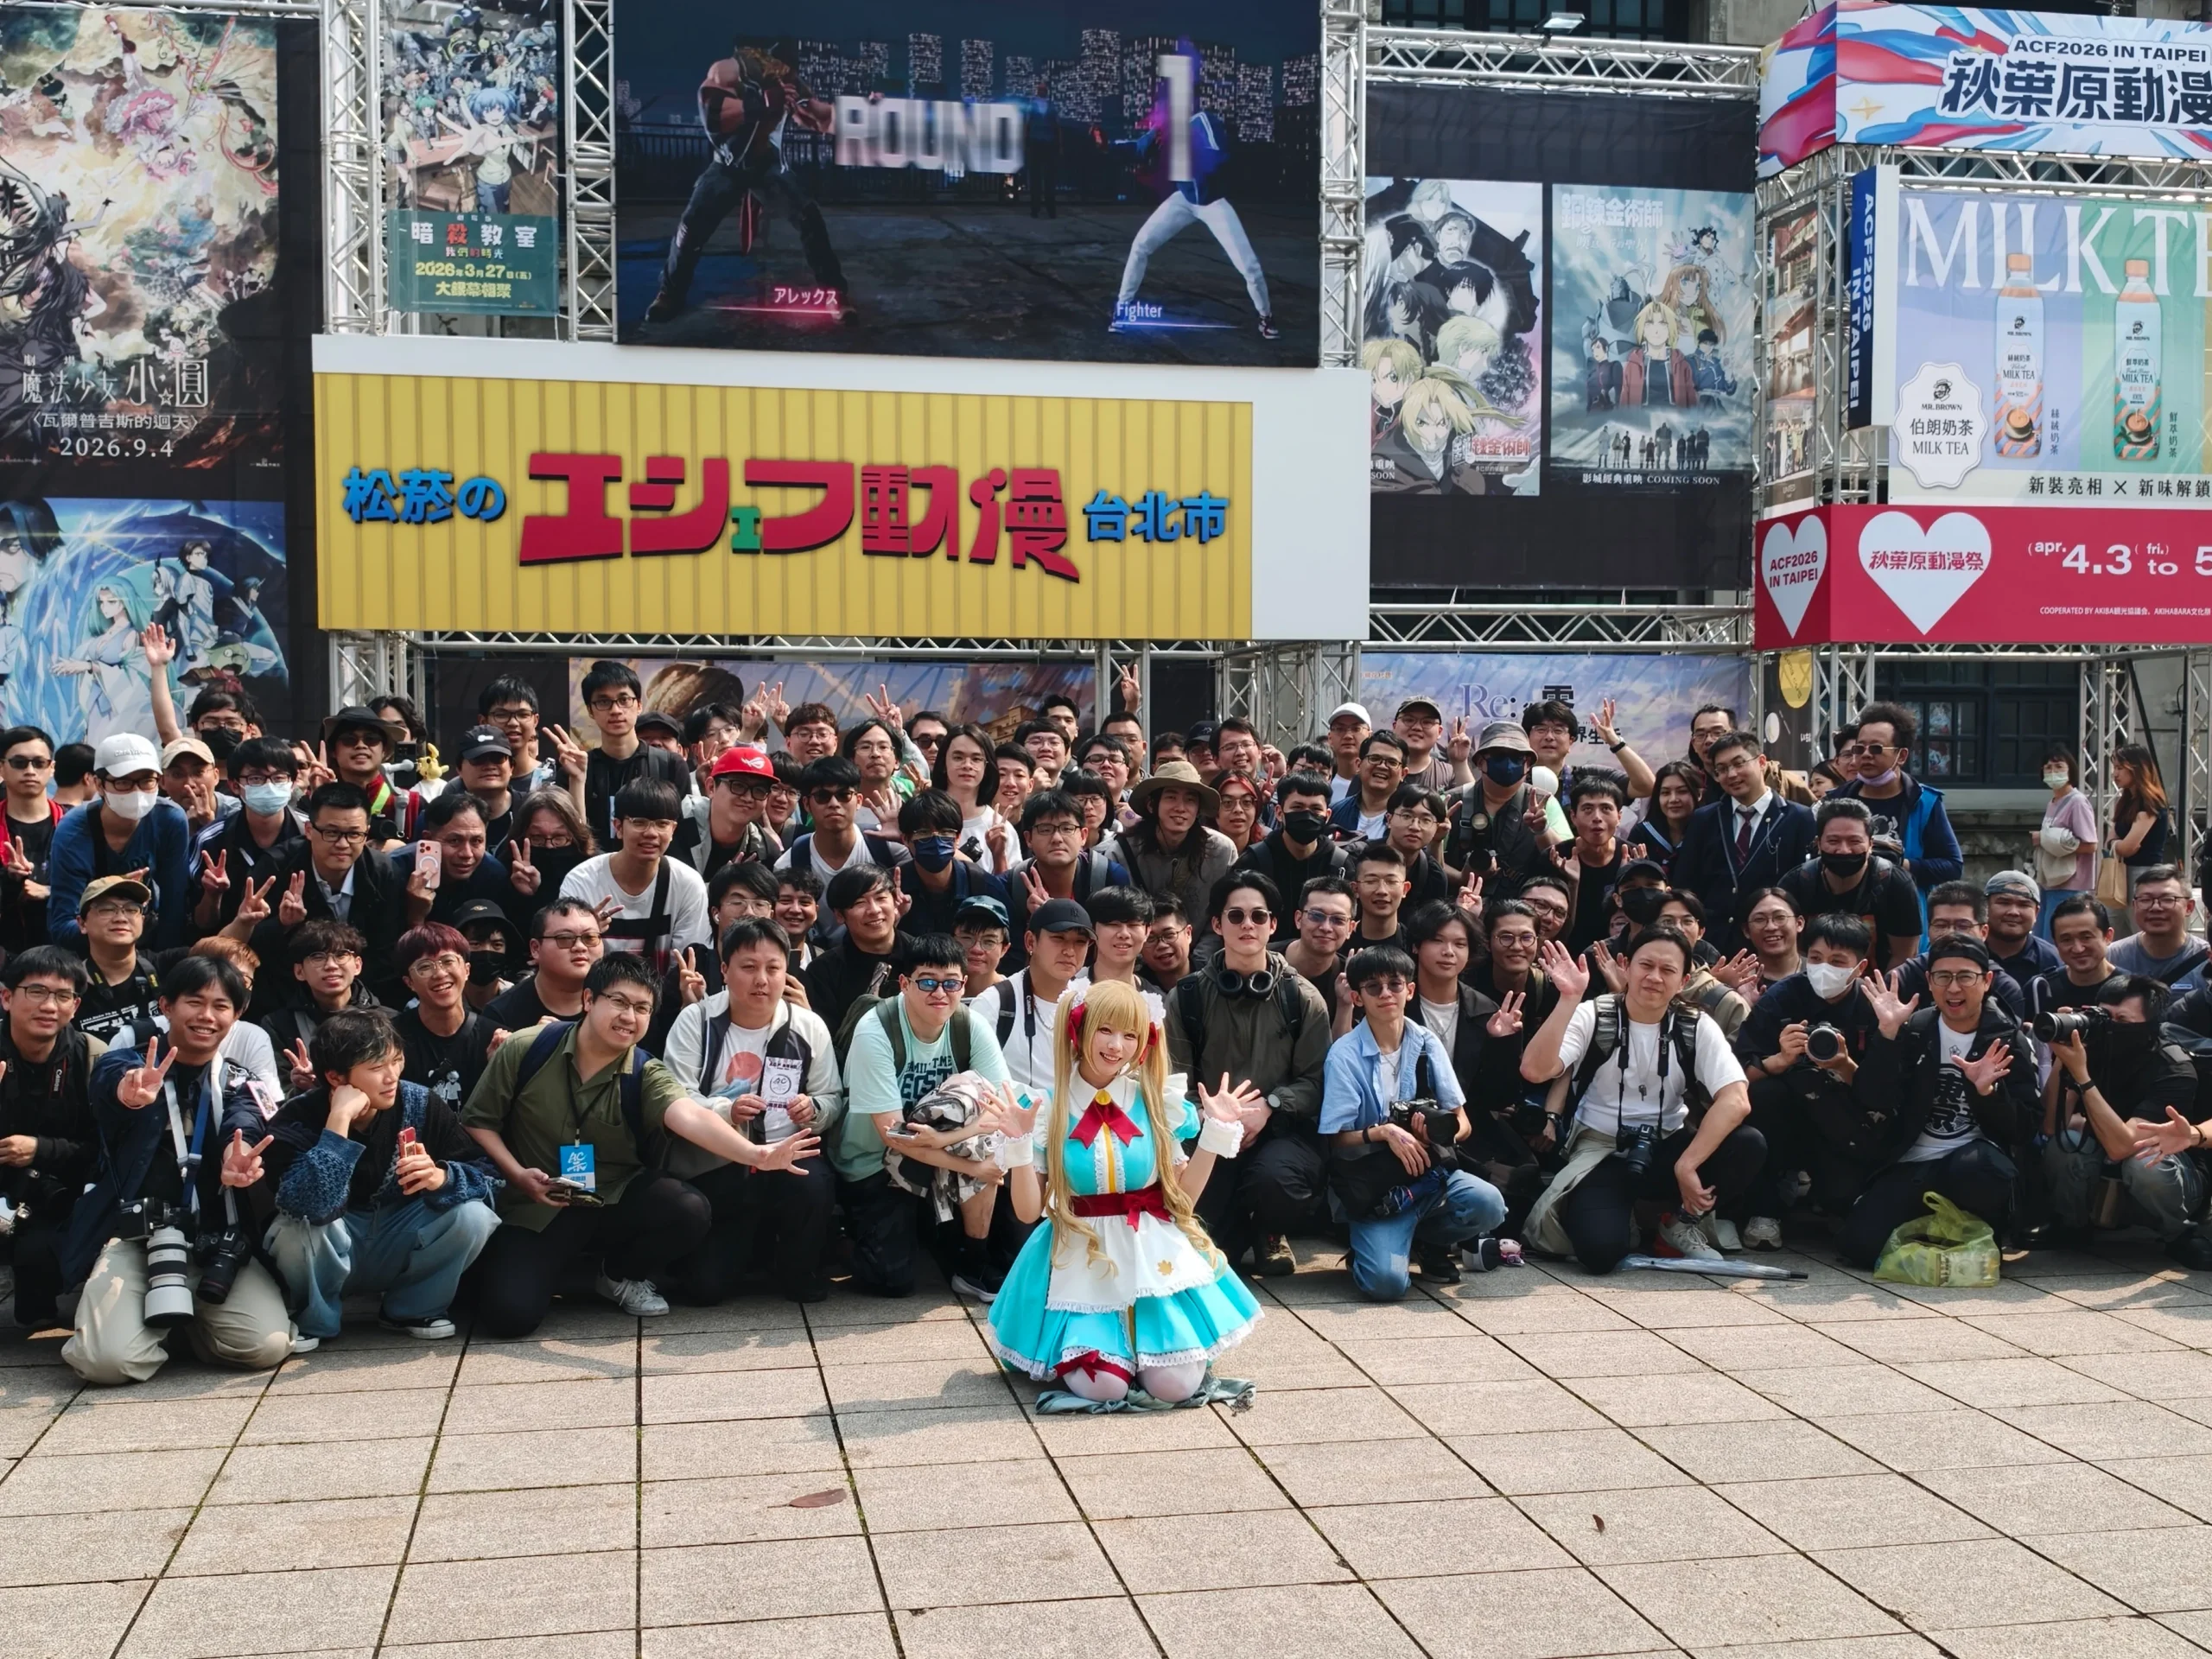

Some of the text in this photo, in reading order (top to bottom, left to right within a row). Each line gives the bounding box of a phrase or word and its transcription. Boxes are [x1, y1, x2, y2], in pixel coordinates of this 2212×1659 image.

[2014, 39, 2207, 62] ACF2026 IN TAIPEI
[1941, 55, 2212, 125] 秋葉原動漫
[835, 95, 1024, 174] ROUND
[411, 221, 537, 249] 暗殺教室
[1904, 198, 2120, 295] MILK
[1862, 193, 1874, 333] ACF2026
[774, 288, 838, 305] アレックス
[1116, 301, 1162, 322] Fighter
[1849, 267, 1861, 410] IN TAIPEI
[2003, 370, 2035, 380] MILK TEA
[2122, 373, 2153, 384] MILK TEA
[1910, 418, 1974, 436] 伯朗奶茶
[60, 437, 173, 458] 2026.9.4
[1912, 441, 1969, 455] MILK TEA
[1647, 475, 1690, 485] COMING
[1693, 477, 1720, 486] SOON
[2029, 476, 2102, 496] 新裝亮相
[2139, 479, 2211, 499] 新味解鎖
[342, 467, 507, 524] 松菸の
[1083, 490, 1230, 545] 台北市
[1770, 550, 1818, 571] ACF2026
[1868, 550, 1984, 570] 秋葉原動漫祭
[2062, 543, 2133, 575] 4.3
[2147, 559, 2179, 575] to
[1770, 568, 1818, 588] IN TAIPEI
[2039, 607, 2083, 615] COOPERATED
[1459, 683, 1517, 719] Re:
[54, 1069, 62, 1091] Canon
